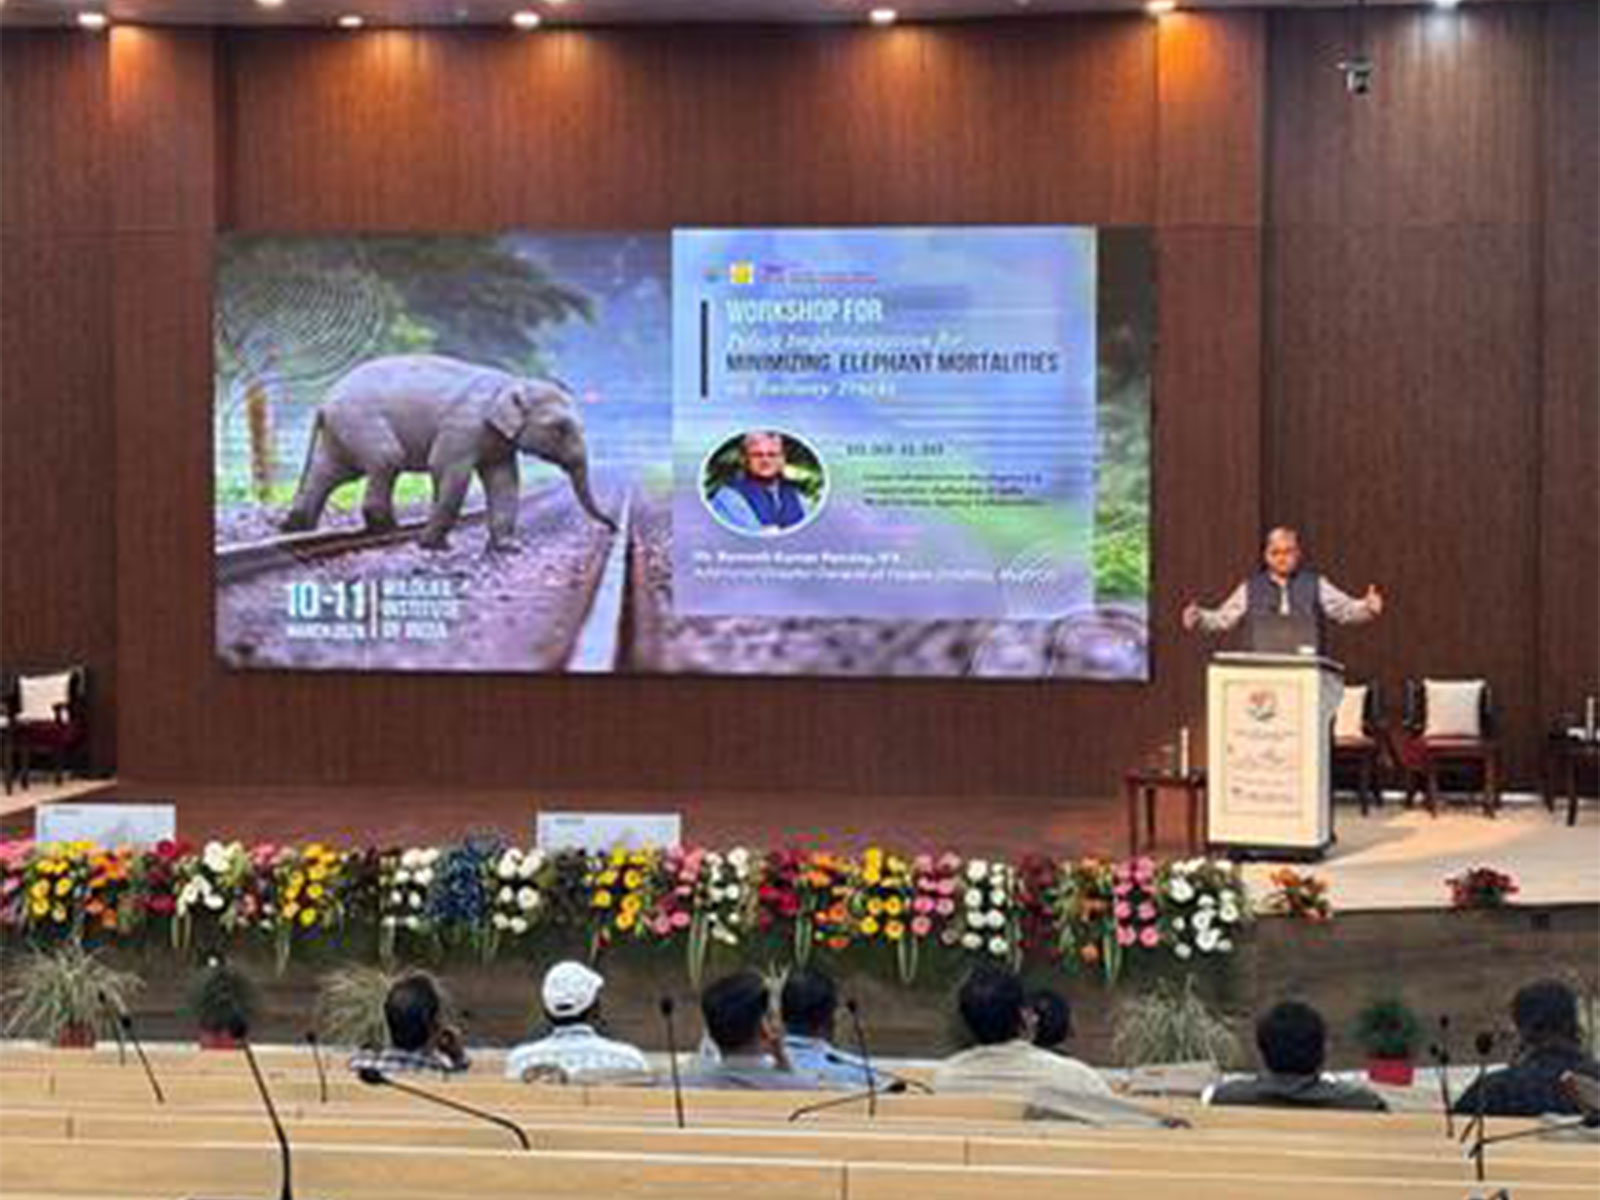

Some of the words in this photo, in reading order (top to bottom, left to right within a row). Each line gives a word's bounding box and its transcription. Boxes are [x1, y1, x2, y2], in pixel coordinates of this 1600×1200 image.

[844, 298, 883, 324] FOR
[726, 352, 830, 373] MINIMIZING
[838, 352, 933, 374] ELEPHANT
[937, 352, 1059, 374] MORTALITIES
[283, 579, 367, 620] 10-11
